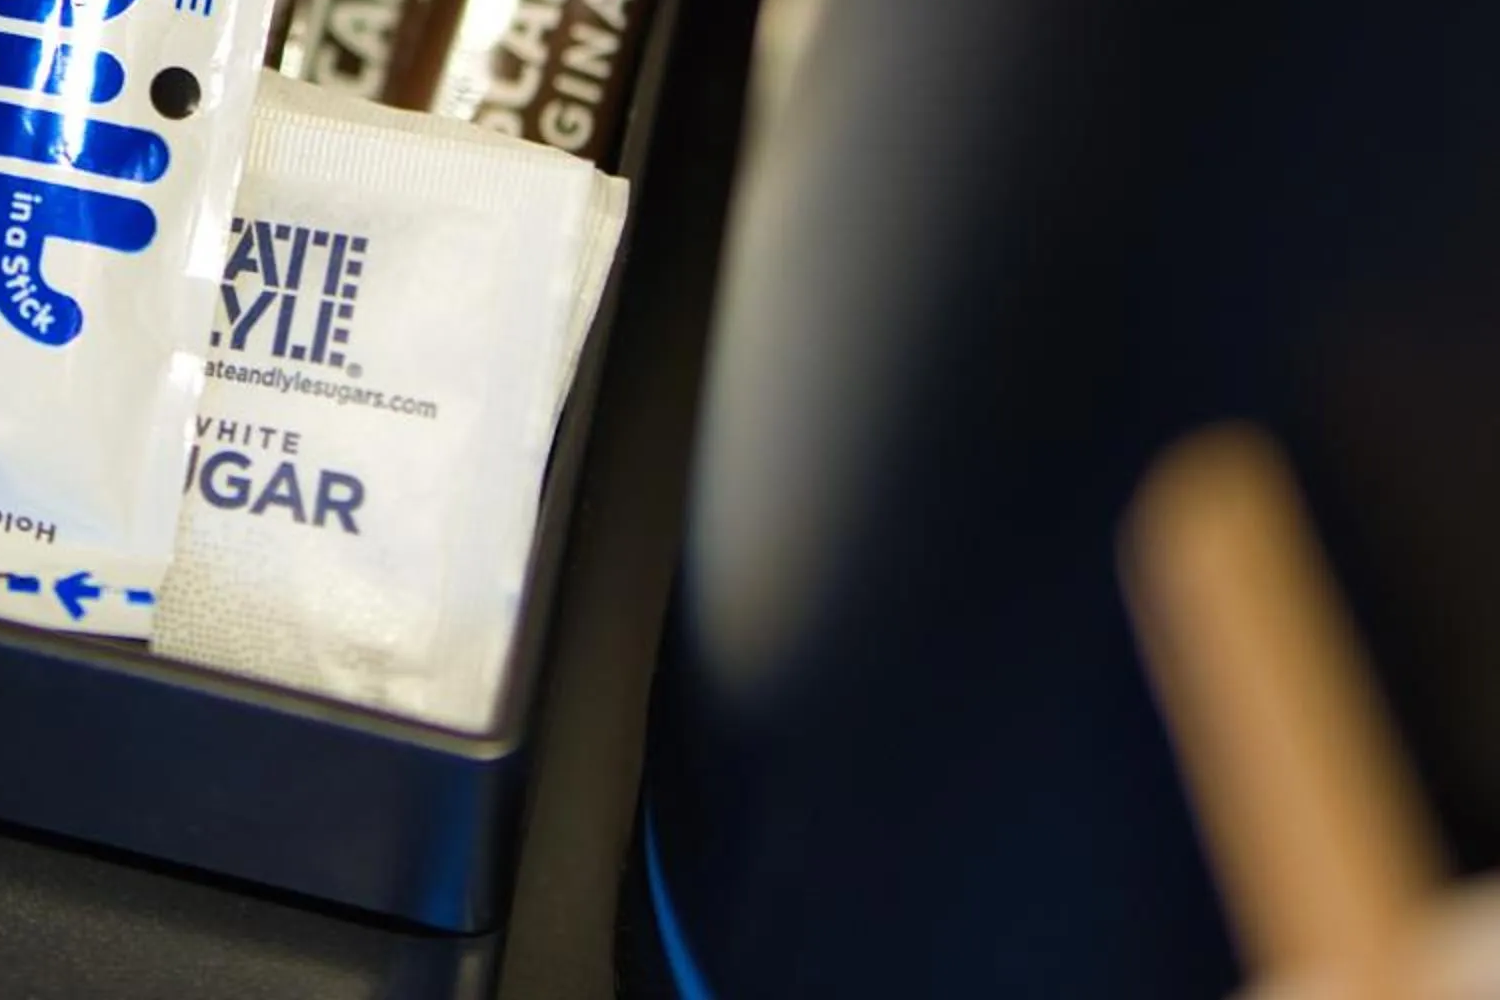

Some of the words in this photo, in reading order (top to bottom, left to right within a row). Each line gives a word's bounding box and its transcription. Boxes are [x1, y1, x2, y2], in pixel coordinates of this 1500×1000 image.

[10, 192, 42, 222] in
[4, 226, 27, 249] a
[210, 283, 355, 369] YLE
[204, 361, 438, 419] ateandlylesugars.com
[183, 444, 365, 535] GAR
